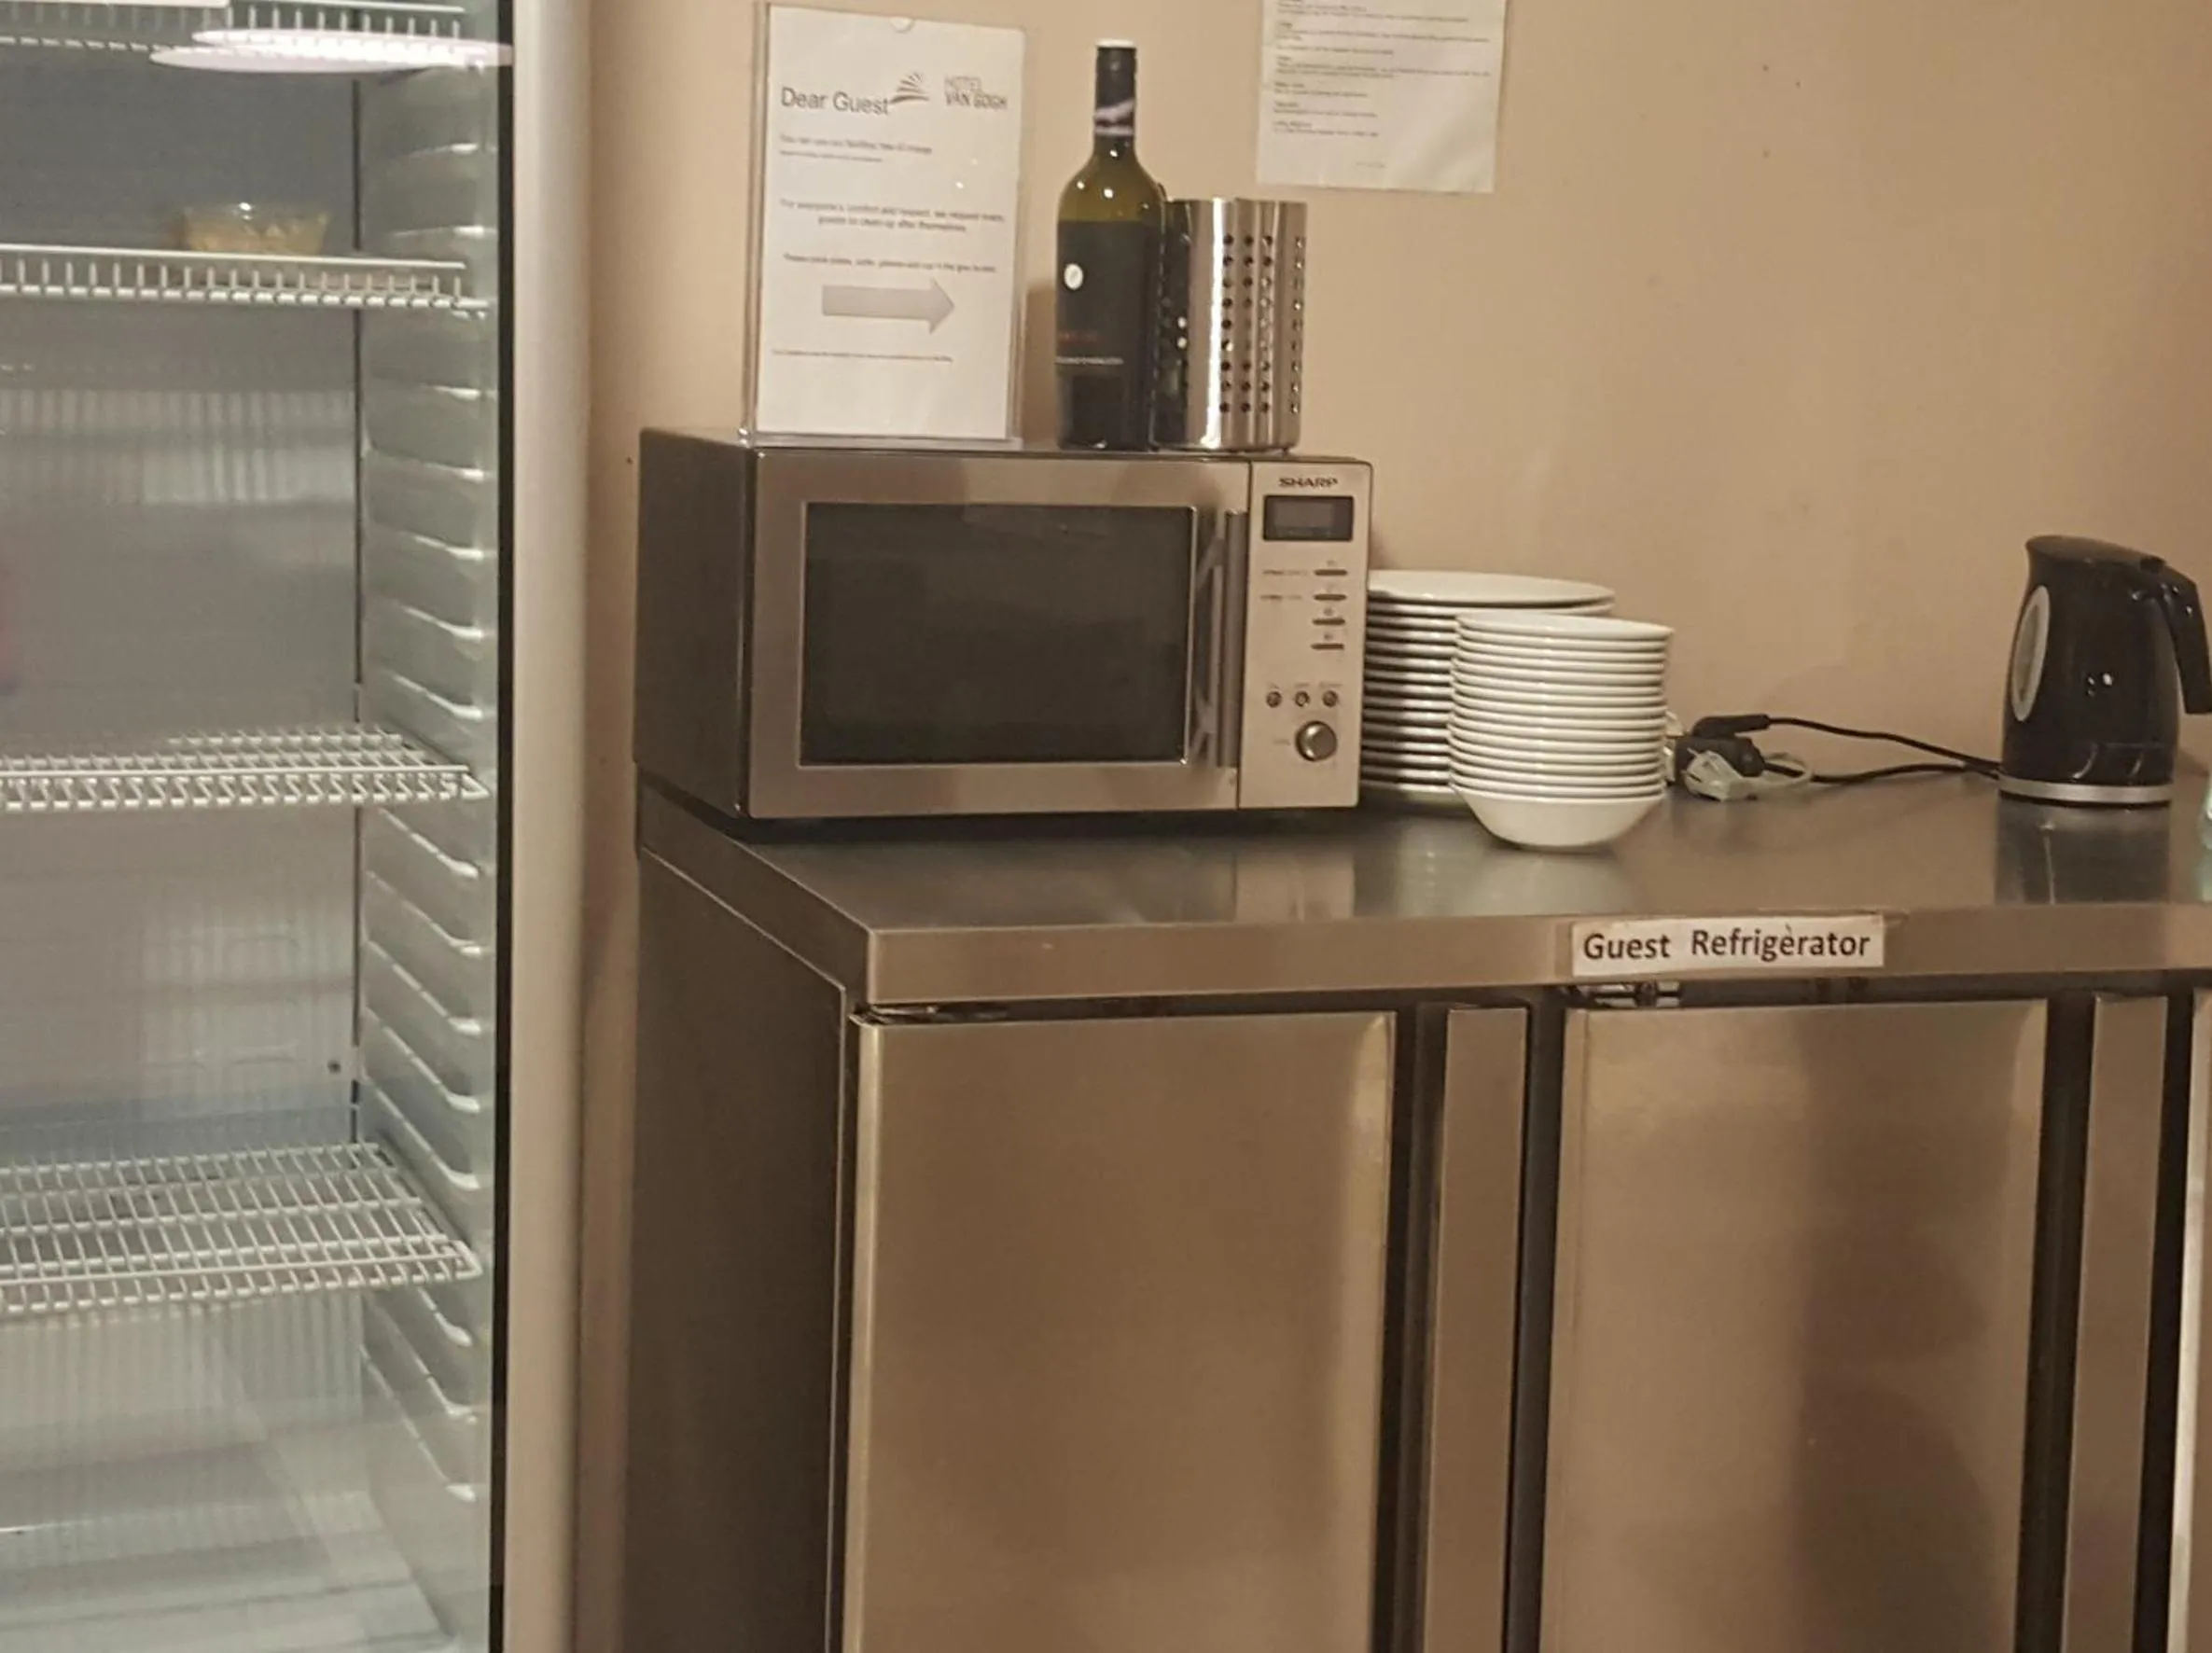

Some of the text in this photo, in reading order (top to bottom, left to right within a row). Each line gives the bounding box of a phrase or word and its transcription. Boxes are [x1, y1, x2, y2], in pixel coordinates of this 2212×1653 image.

[781, 87, 889, 115] Dear Guest
[1278, 477, 1338, 488] SHARP
[1583, 929, 1871, 962] Guest Refrigerator
